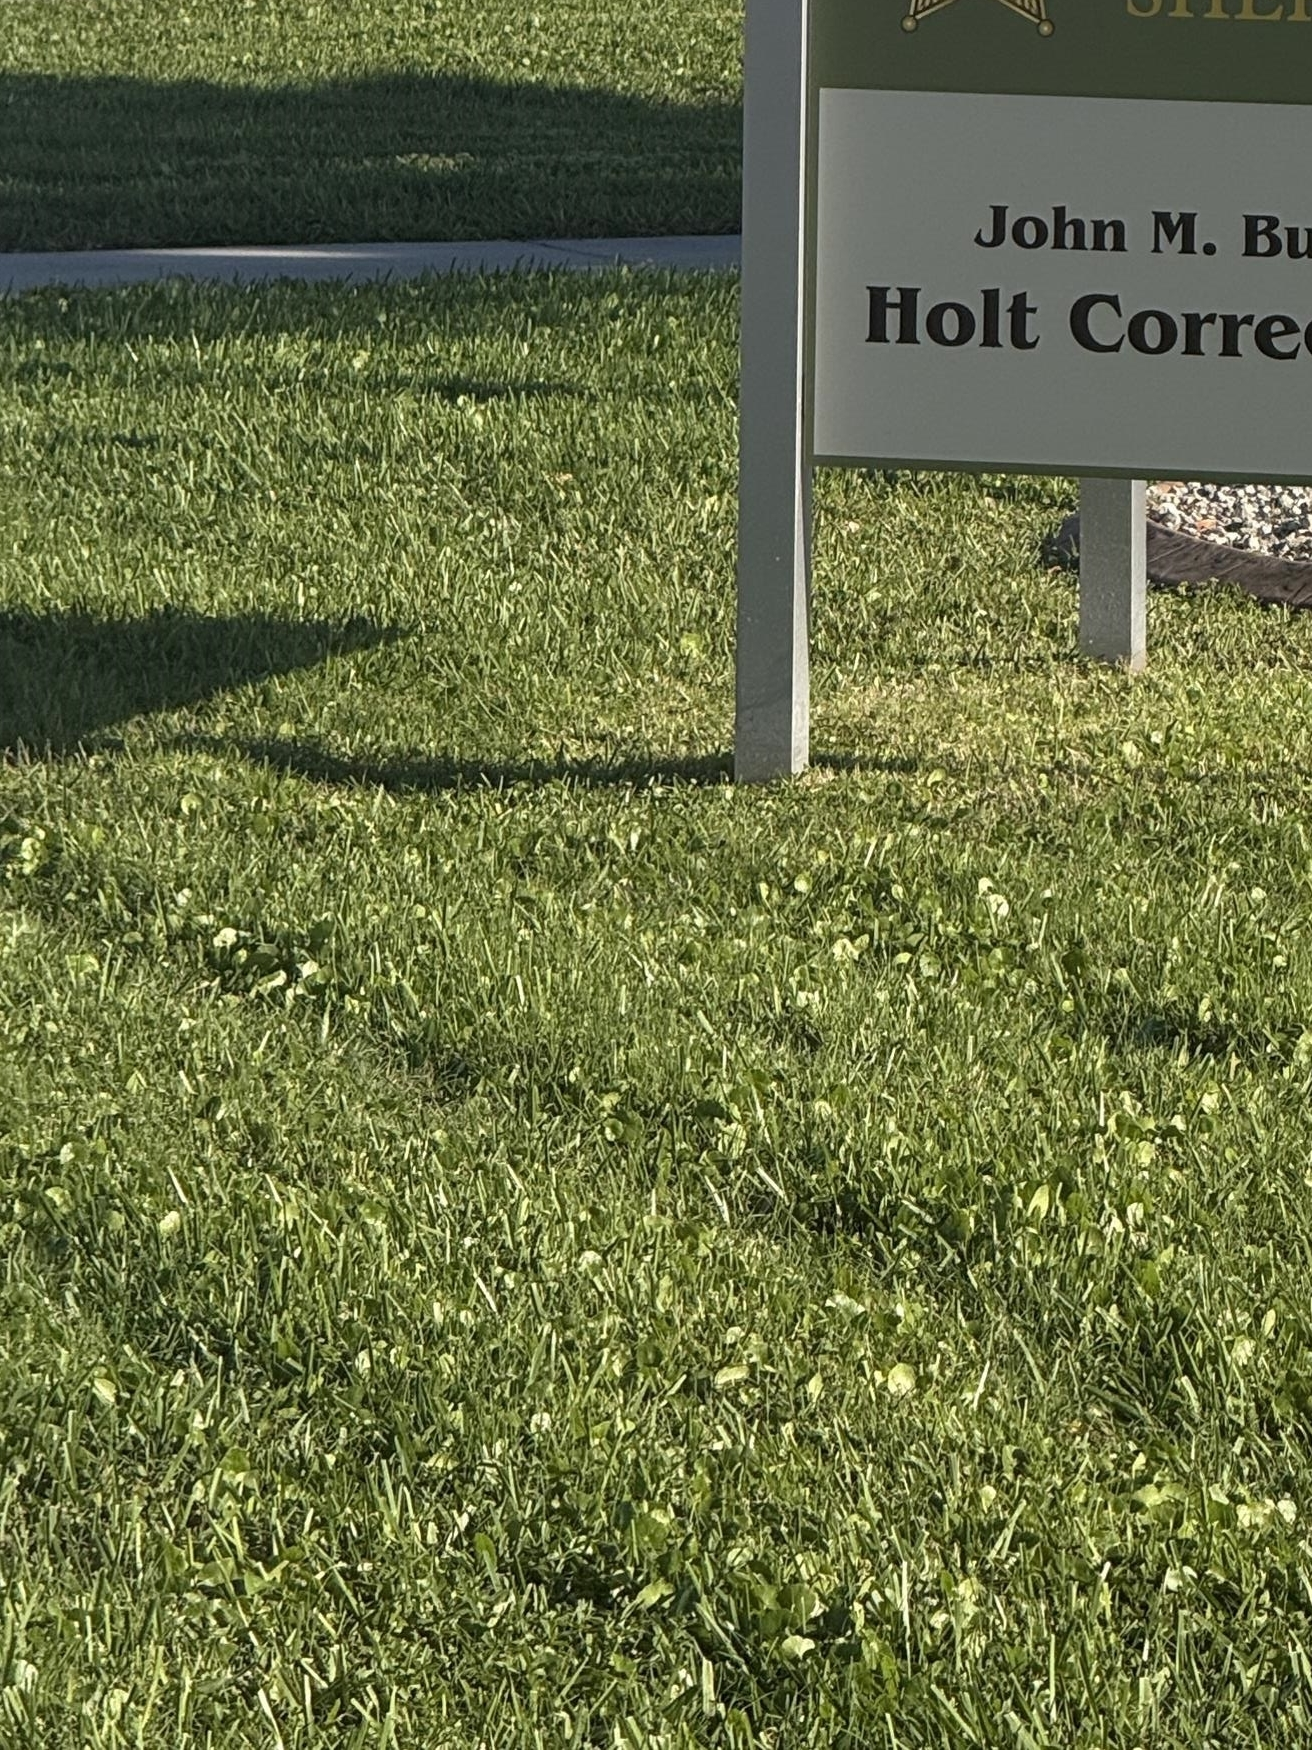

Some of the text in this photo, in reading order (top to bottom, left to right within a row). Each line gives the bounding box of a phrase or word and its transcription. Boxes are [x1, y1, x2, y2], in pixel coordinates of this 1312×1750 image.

[974, 204, 1128, 253] John
[1150, 210, 1217, 257] M.
[864, 285, 1041, 351] Holt
